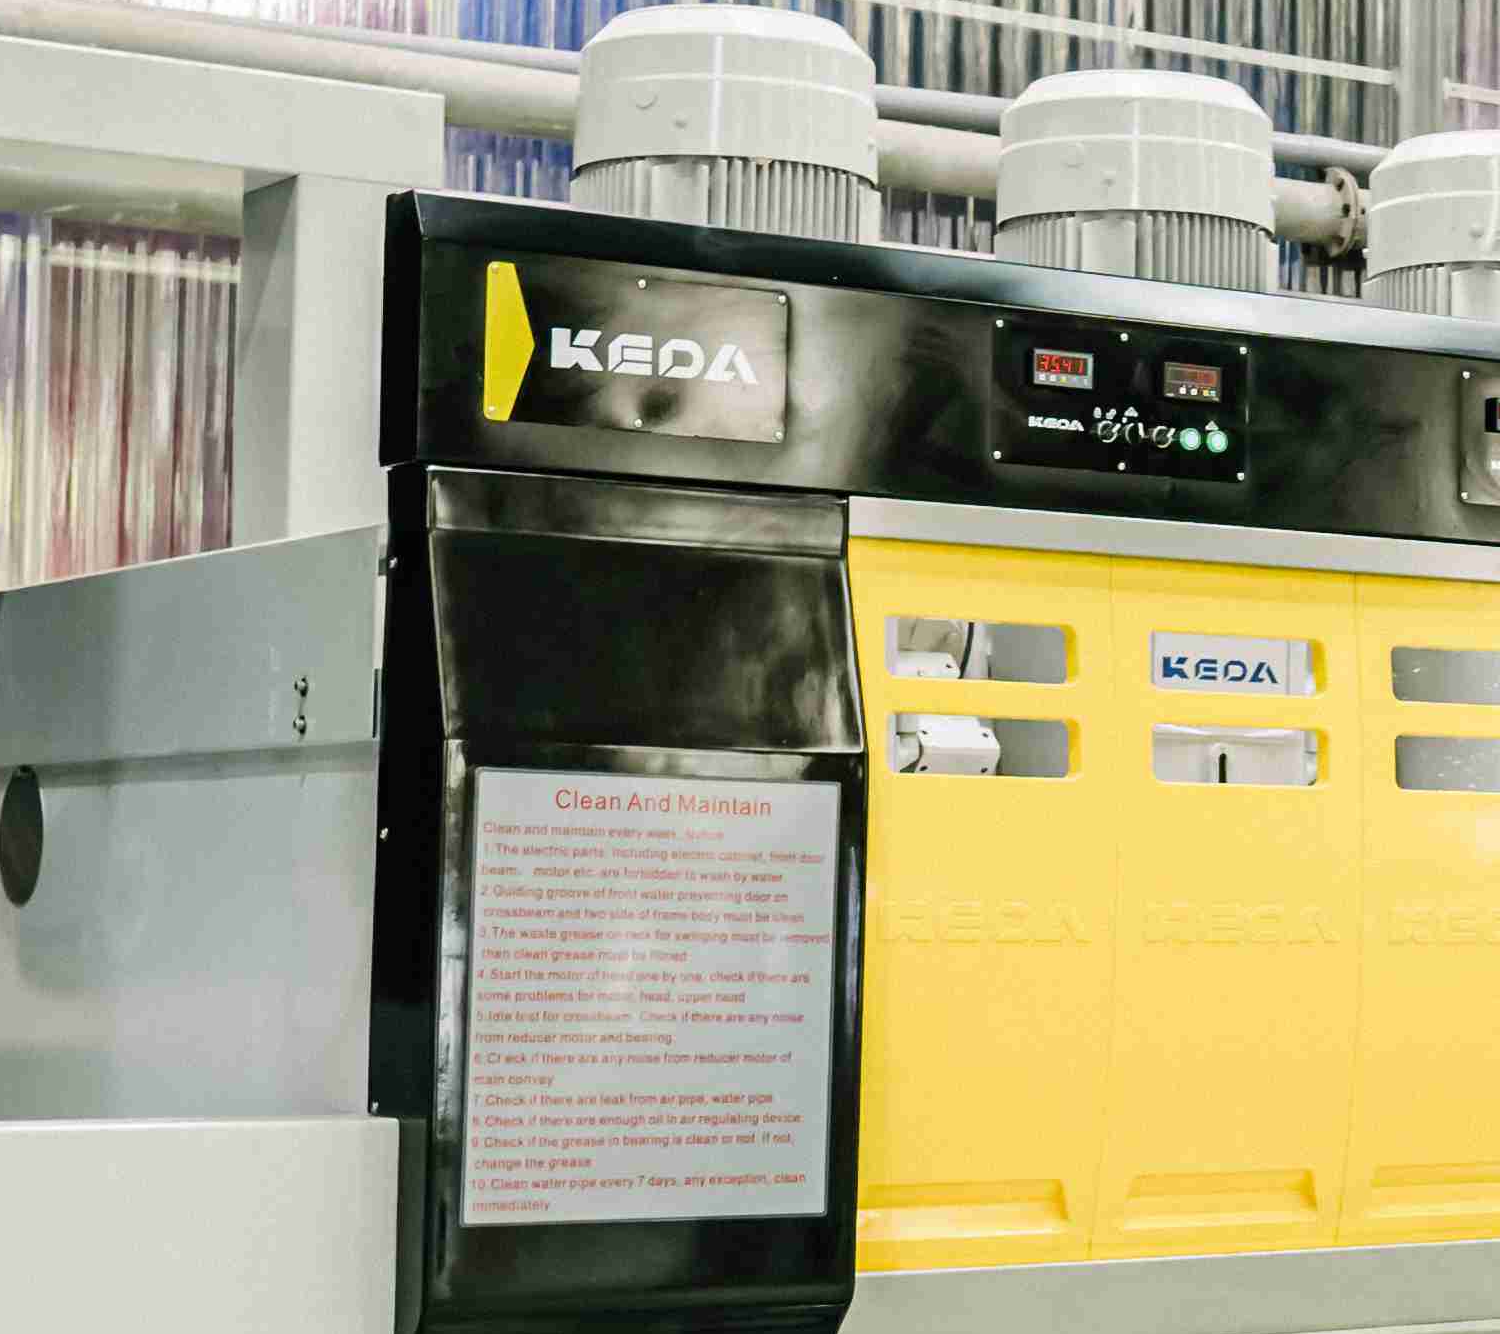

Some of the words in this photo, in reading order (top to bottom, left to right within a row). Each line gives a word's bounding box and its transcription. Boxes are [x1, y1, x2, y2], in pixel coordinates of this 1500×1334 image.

[550, 327, 759, 384] KEDA
[1028, 415, 1085, 432] KEDA
[1162, 656, 1279, 684] KEDA
[554, 788, 621, 811] Clean
[626, 791, 670, 813] And
[677, 793, 772, 816] Maintain
[483, 821, 521, 833] Clean
[524, 822, 548, 834] and
[550, 823, 605, 836] maintain
[607, 827, 643, 839] every
[521, 844, 569, 856] electric
[531, 865, 569, 877] motor
[546, 888, 590, 900] groove
[639, 888, 675, 900] water
[743, 890, 771, 902] door
[558, 908, 580, 918] and
[518, 927, 557, 939] waste
[560, 930, 604, 942] grease
[481, 948, 511, 959] then
[550, 951, 596, 962] grease
[523, 969, 546, 980] the
[547, 969, 583, 980] motor
[709, 971, 745, 981] check
[477, 993, 512, 1001] some
[514, 991, 574, 1003] problems
[541, 1011, 560, 1021] for
[690, 1011, 723, 1021] there
[725, 1013, 748, 1021] are
[749, 1013, 769, 1023] any
[475, 1033, 504, 1042] from
[507, 1033, 556, 1042] reducer
[599, 1033, 624, 1042] and
[541, 1052, 575, 1063] there
[577, 1054, 599, 1063] are
[601, 1054, 625, 1065] any
[663, 1051, 691, 1063] from
[540, 1094, 573, 1105] there
[576, 1096, 597, 1104] are
[598, 1093, 625, 1104] leak
[628, 1093, 658, 1104] from
[660, 1093, 675, 1103] air
[711, 1092, 746, 1103] water
[539, 1115, 573, 1126] there
[575, 1117, 596, 1125] are
[598, 1114, 646, 1127] enough
[647, 1114, 666, 1124] oil
[680, 1113, 697, 1123] air
[698, 1112, 759, 1125] regulating
[539, 1135, 558, 1146] the
[560, 1136, 605, 1148] grease
[684, 1132, 719, 1144] clean
[473, 1158, 522, 1171] change
[524, 1158, 546, 1168] the
[548, 1159, 592, 1170] grease
[530, 1177, 567, 1188] water
[568, 1177, 597, 1189] pipe
[598, 1178, 634, 1189] every
[683, 1176, 706, 1186] any
[772, 1172, 804, 1182] clean
